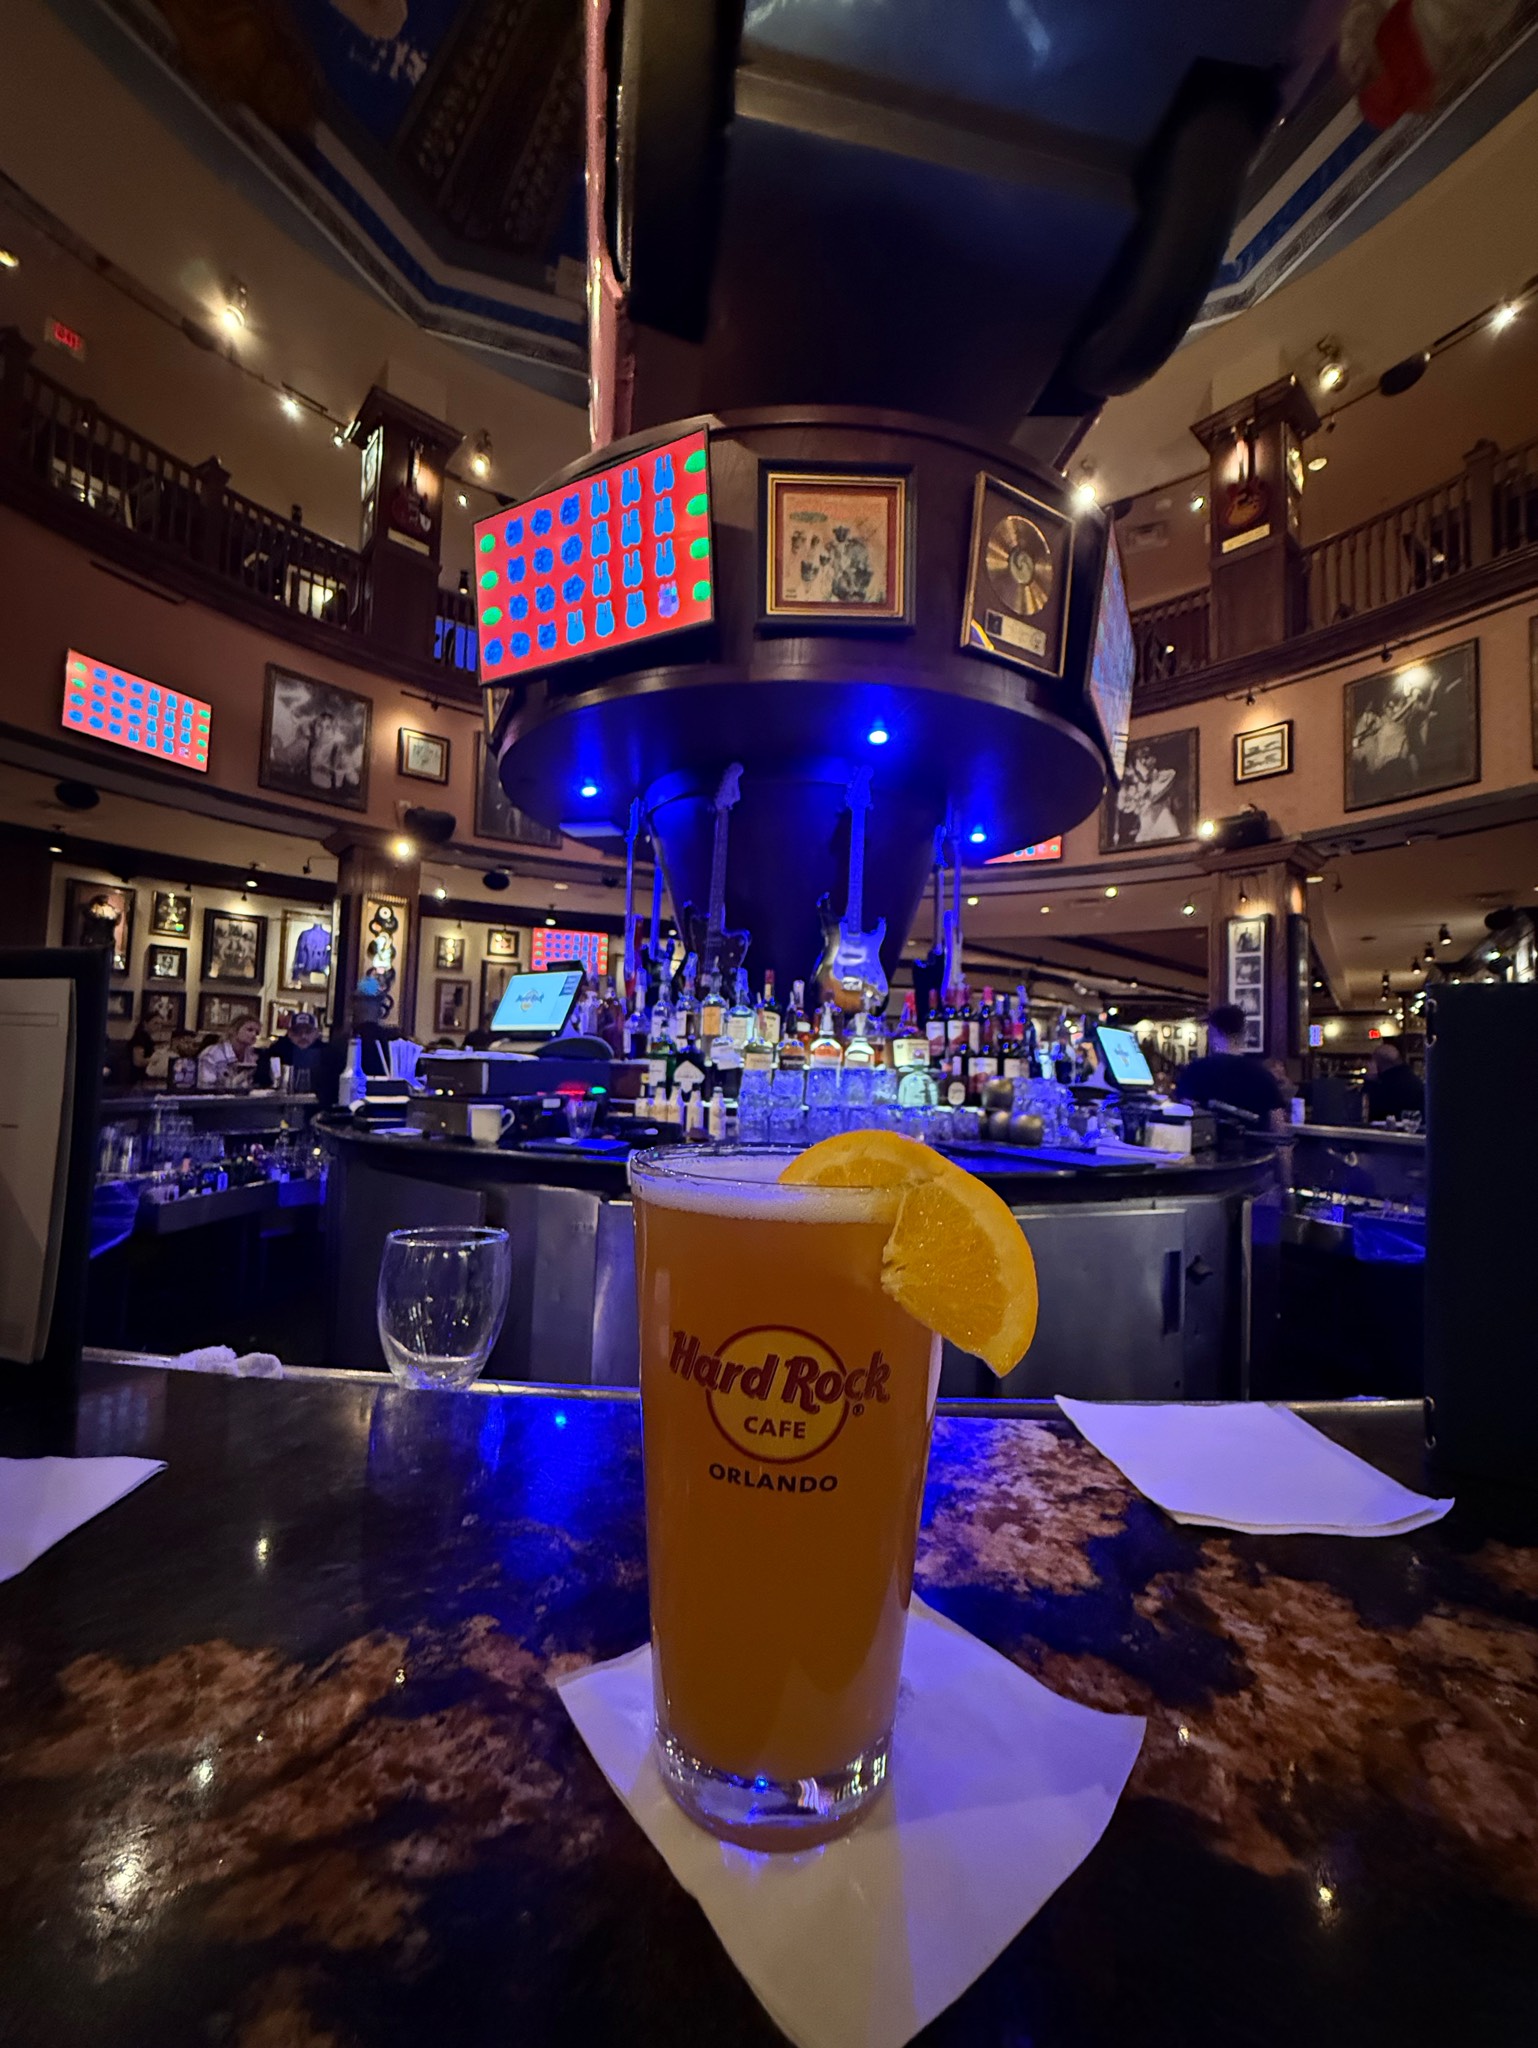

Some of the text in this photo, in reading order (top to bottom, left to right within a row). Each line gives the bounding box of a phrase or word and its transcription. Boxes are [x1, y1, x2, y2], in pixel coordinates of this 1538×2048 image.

[669, 1330, 890, 1415] Hard Rock
[743, 1416, 806, 1439] CAFE
[708, 1463, 838, 1493] ORLANDO
